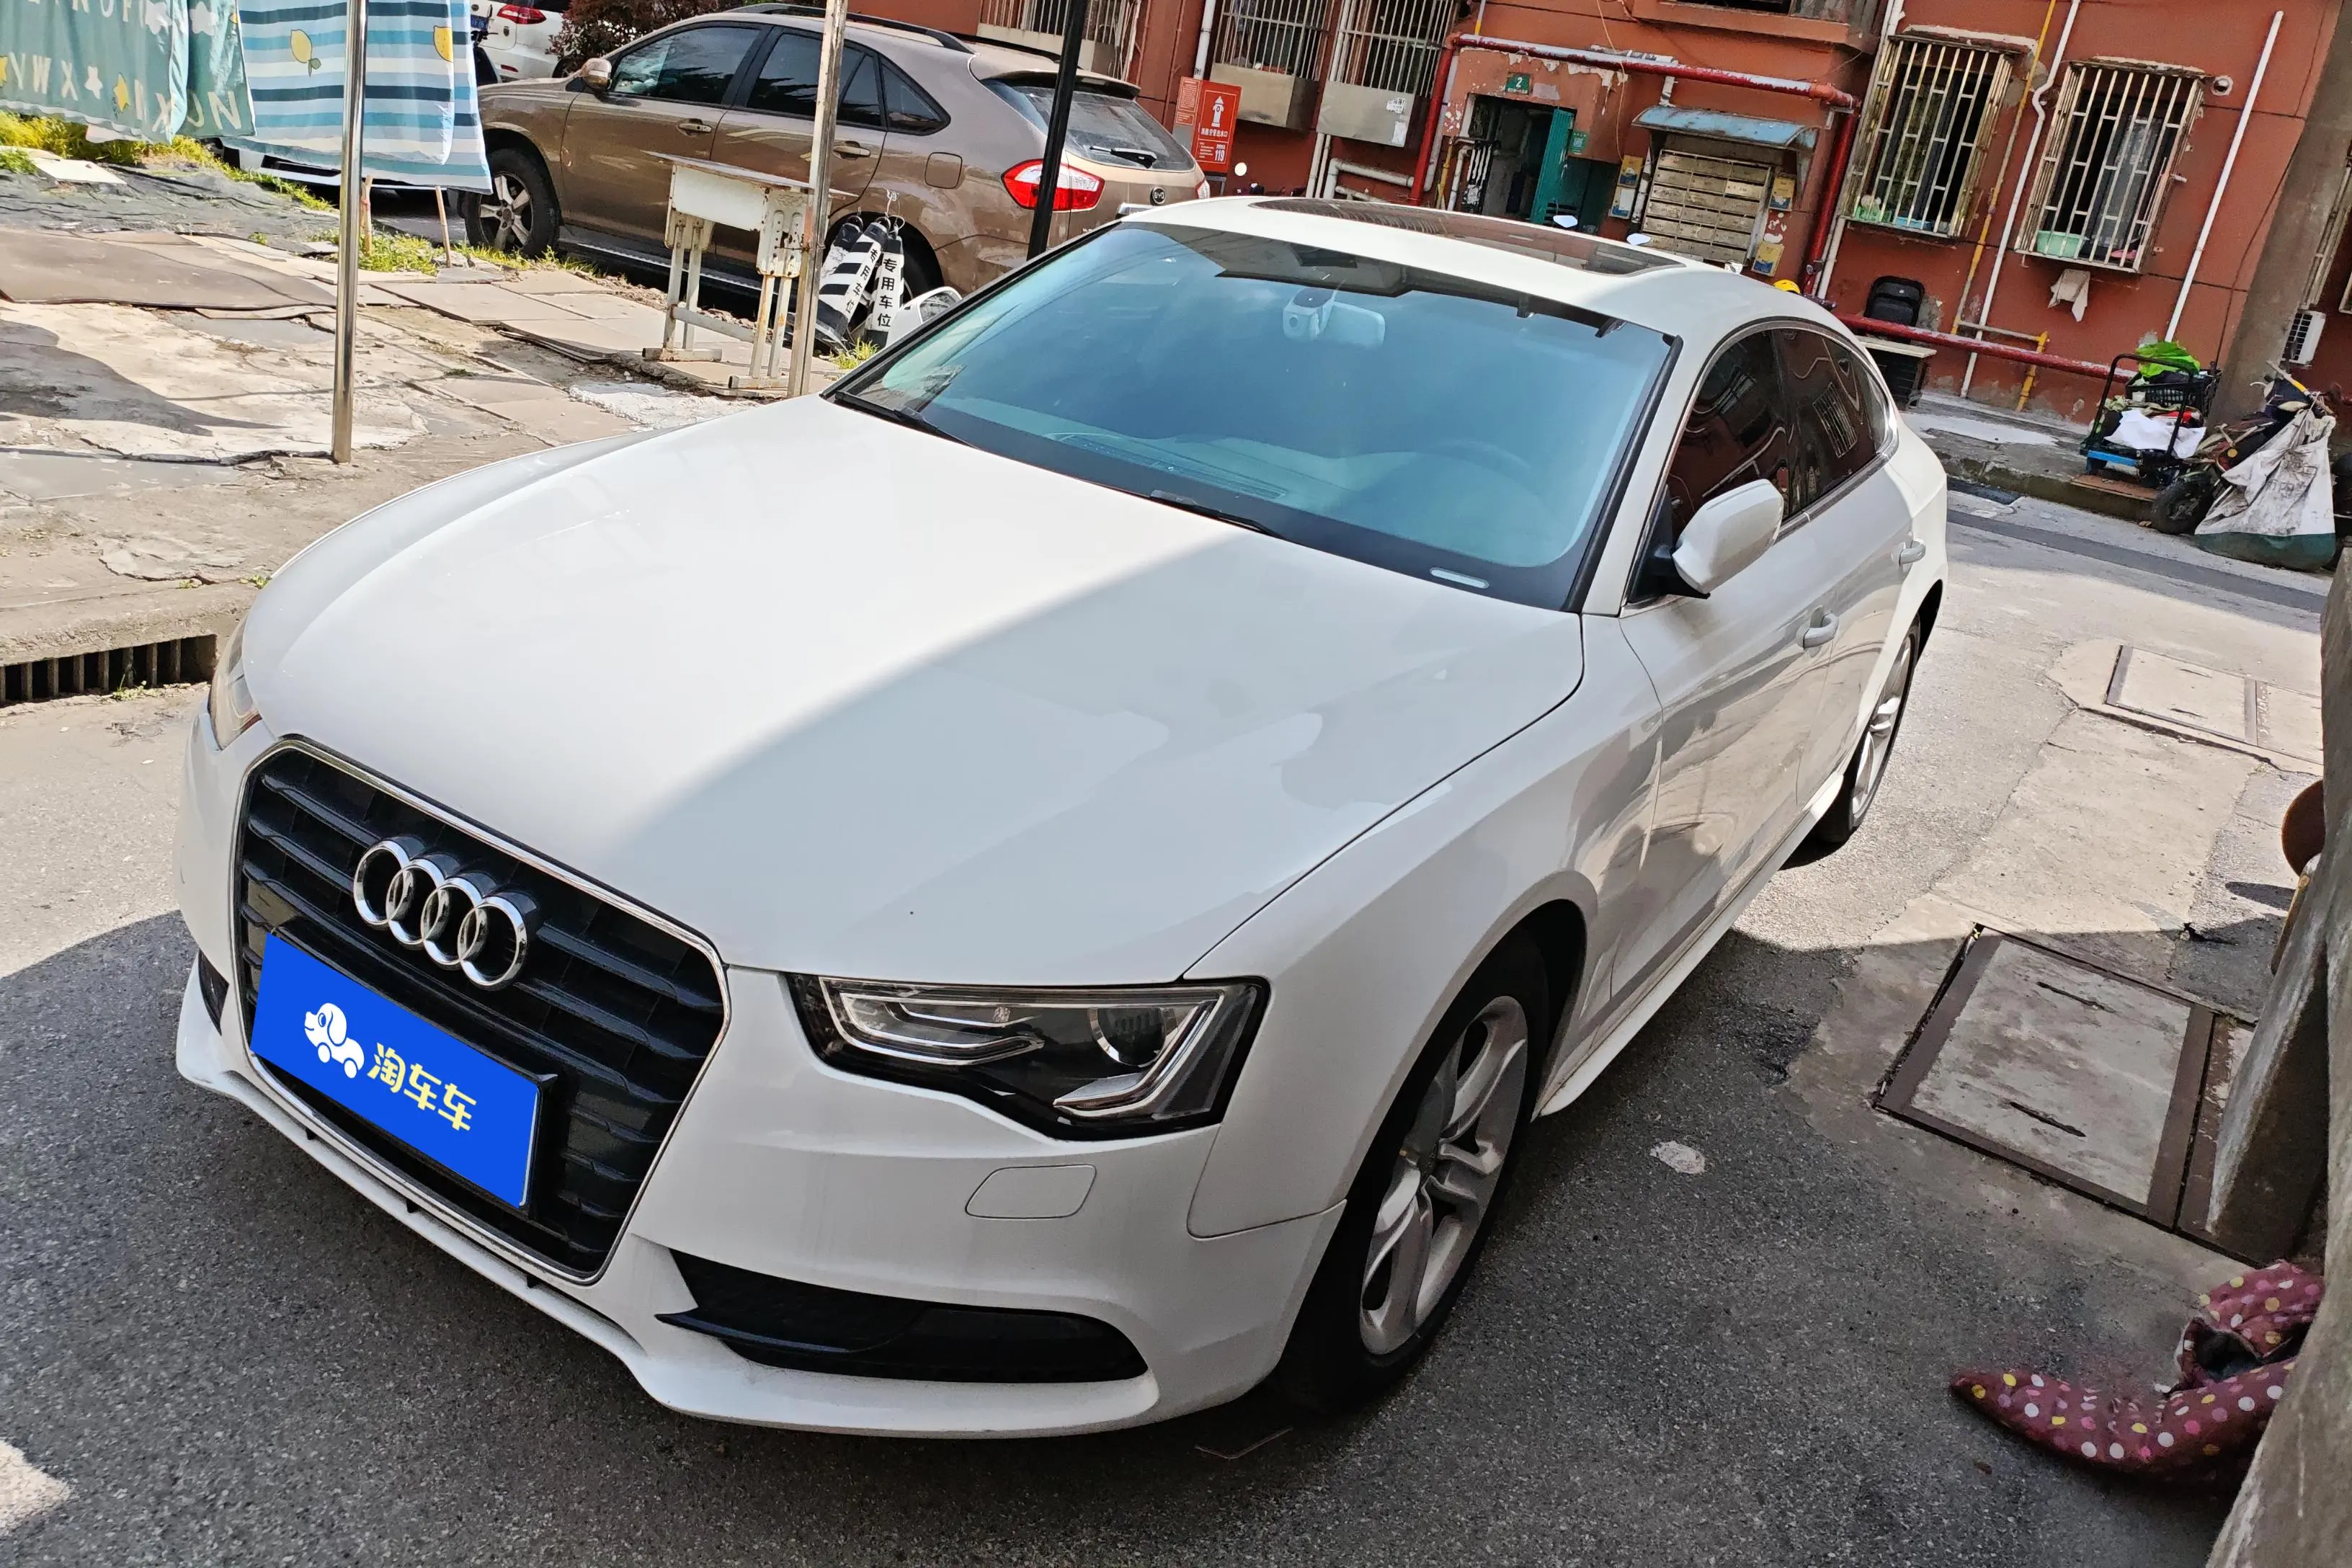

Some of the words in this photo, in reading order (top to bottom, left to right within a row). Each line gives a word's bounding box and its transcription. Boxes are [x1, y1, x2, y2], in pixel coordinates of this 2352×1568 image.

[1515, 76, 1523, 87] 2
[1214, 149, 1225, 161] 119
[845, 249, 878, 314] 专用车位
[877, 258, 898, 328] 专用车位
